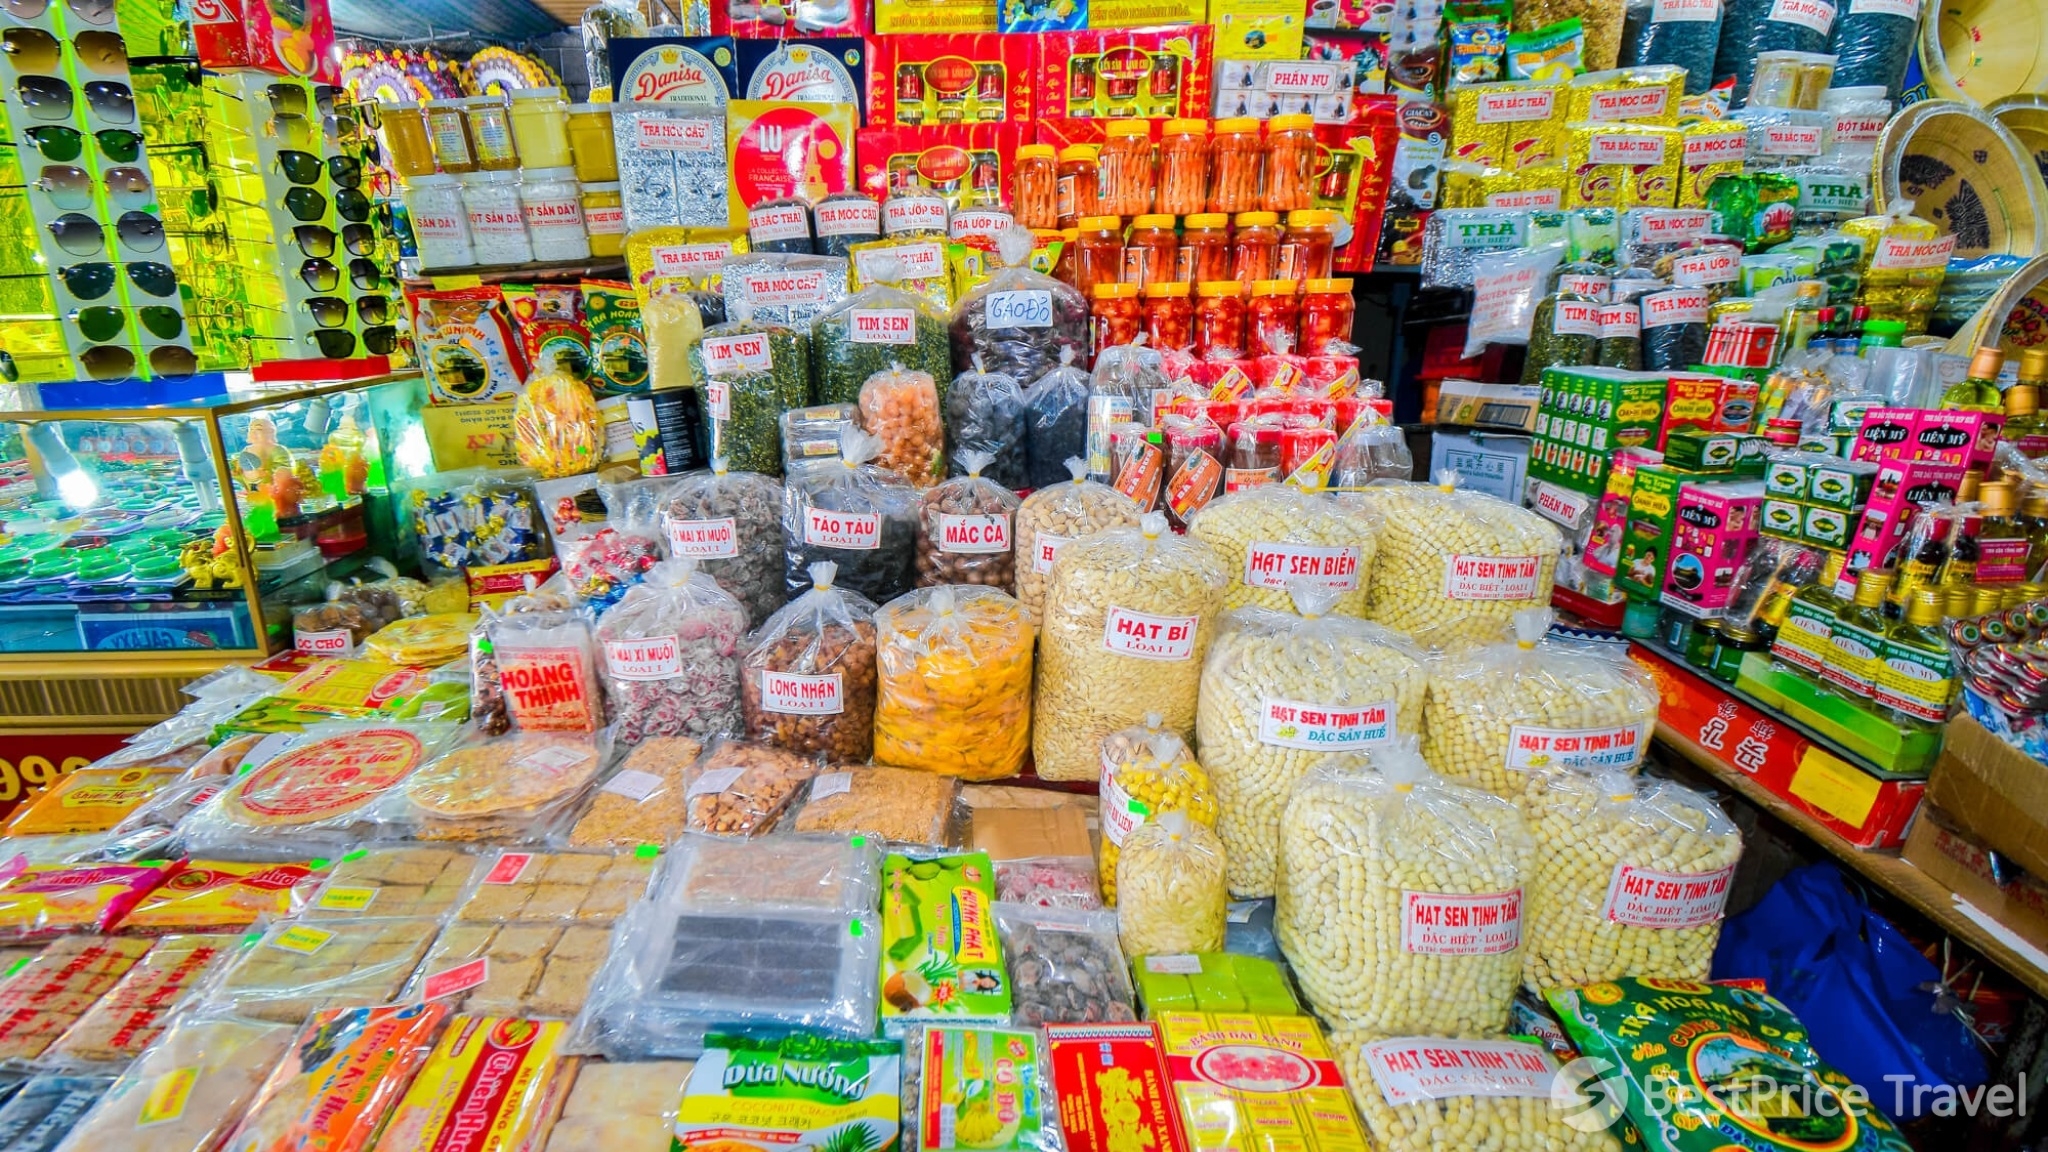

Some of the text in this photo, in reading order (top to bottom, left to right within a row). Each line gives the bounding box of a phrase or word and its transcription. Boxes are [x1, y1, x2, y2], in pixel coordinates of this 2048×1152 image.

[638, 68, 706, 100] Danisa
[765, 66, 834, 100] Danisa
[1274, 70, 1329, 87] PHẤN NỤ
[760, 125, 783, 154] LU
[1808, 183, 1863, 199] TRÀ
[537, 203, 555, 215] SẮN
[1458, 219, 1516, 237] TRÀ
[991, 292, 1024, 319] TÁO
[1565, 307, 1588, 320] TIM
[857, 317, 909, 331] TIM SEN
[1888, 428, 1906, 440] MỸ
[1920, 431, 1967, 445] LIÊN MỸ
[1907, 488, 1934, 500] LIÊN
[812, 515, 875, 536] TÁO TÀU
[1681, 508, 1717, 526] LIÊN MỸ
[679, 528, 695, 543] MAI
[707, 526, 730, 545] MUỘI
[946, 519, 1004, 544] MẮC CA
[1251, 548, 1356, 577] HẠT SEN BIỂN
[1456, 559, 1534, 584] HẠT SEN TỊNH TÂM
[1117, 617, 1189, 642] HẠT BÍ
[647, 643, 674, 663] MUỘI
[501, 662, 574, 690] HOÀNG
[1891, 661, 1935, 681] LIÊN MỸ
[515, 683, 581, 712] THỊNH
[769, 678, 835, 699] LONG NHÃN
[1271, 705, 1386, 730] HẠT SEN TỊNH TÂM
[1307, 724, 1386, 744] ĐẶC SẢN HUẾ
[1519, 728, 1636, 752] HẠT SEN TỊNH TÂM
[1623, 868, 1729, 907] HẠT SEN TỊNH TÂM
[1415, 897, 1518, 932] HẠT SEN TỊNH TÂM
[1189, 1030, 1225, 1047] BÁNH
[1262, 1033, 1303, 1050] XANH
[1669, 1019, 1721, 1048] CUNG
[1382, 1047, 1548, 1078] HẠT SEN TỊNH TÂM
[722, 1060, 864, 1100] Dừa Nướng
[730, 1101, 795, 1112] COCONUT
